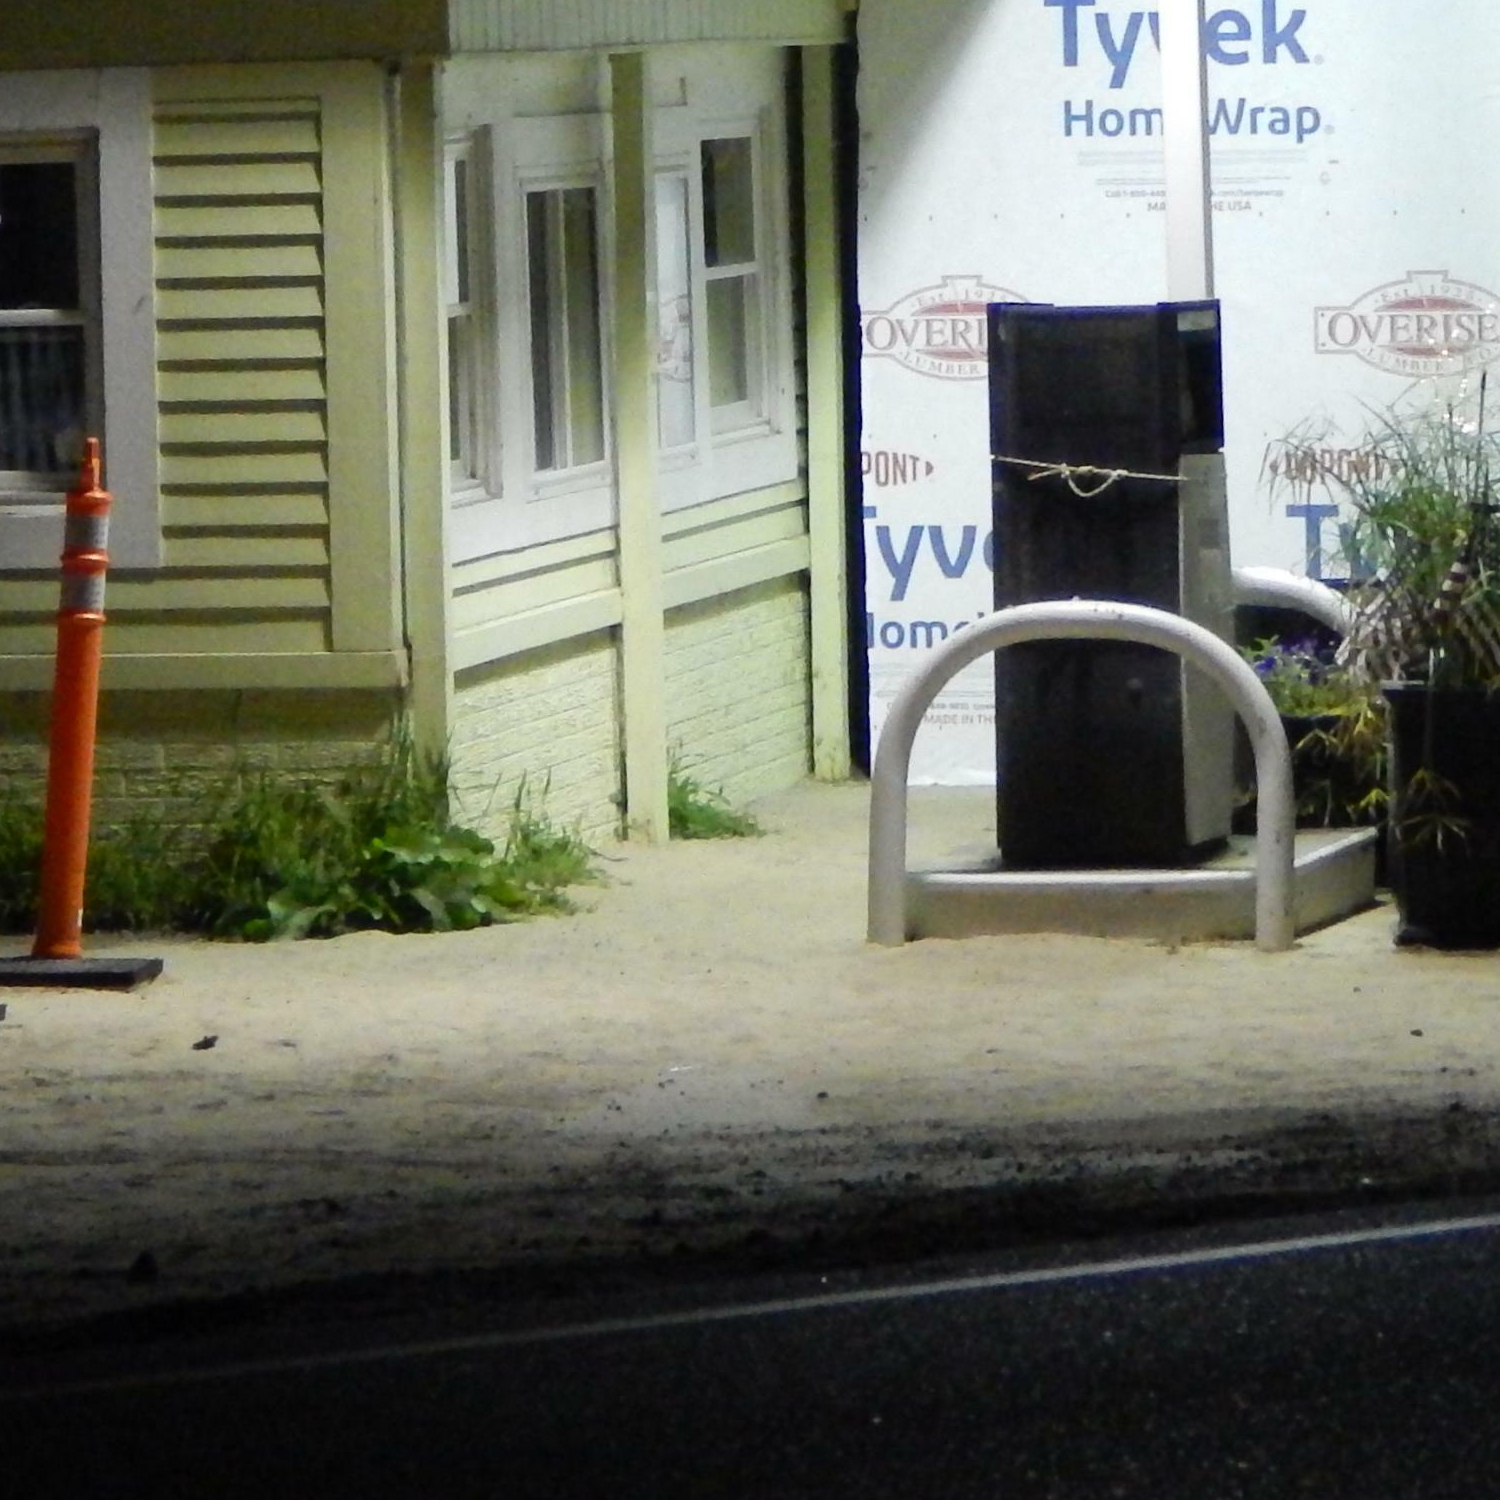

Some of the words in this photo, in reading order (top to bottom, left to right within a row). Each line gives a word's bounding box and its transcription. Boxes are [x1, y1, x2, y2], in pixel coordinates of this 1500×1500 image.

[1063, 99, 1165, 137] Hom
[1208, 97, 1322, 144] Wrap
[866, 316, 988, 353] OVERI
